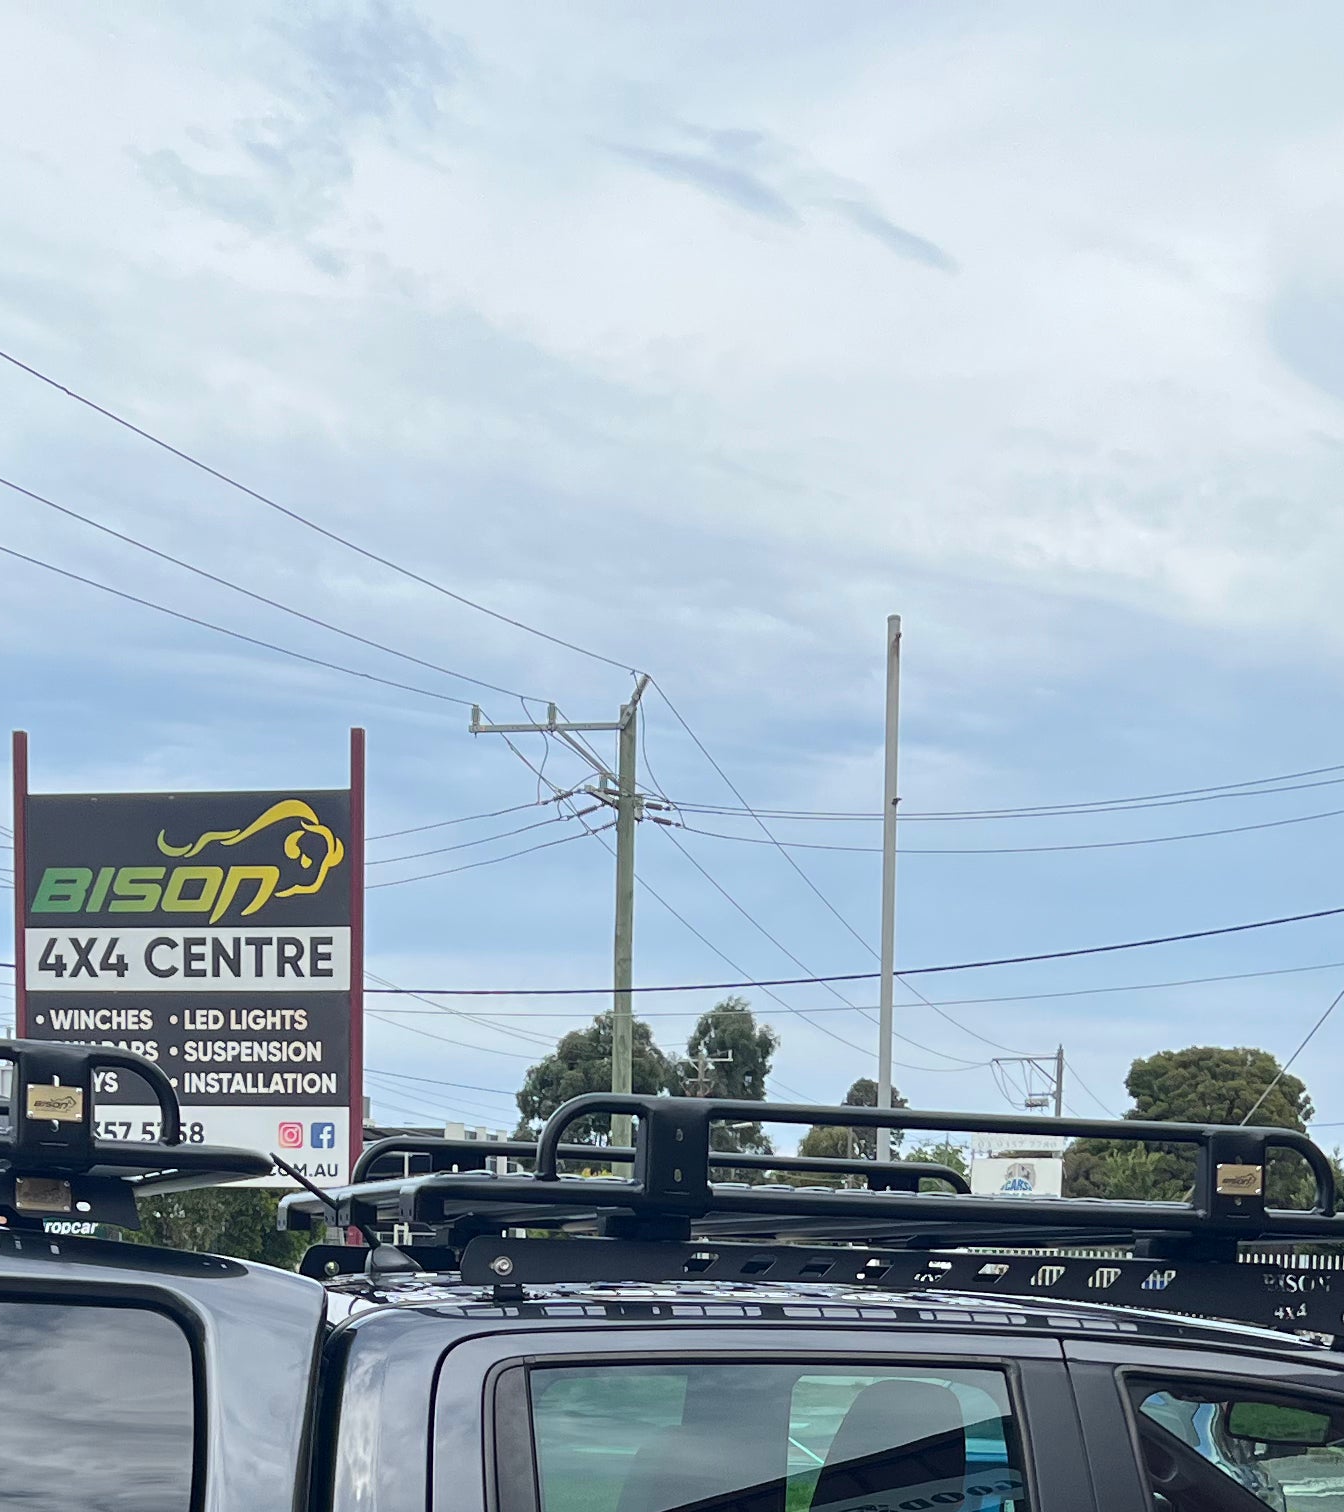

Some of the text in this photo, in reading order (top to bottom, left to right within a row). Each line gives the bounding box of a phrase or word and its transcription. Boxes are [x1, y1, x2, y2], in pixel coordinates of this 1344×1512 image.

[30, 865, 280, 925] BISON
[38, 936, 334, 979] 4X4 CENTRE
[49, 1008, 309, 1031] WINCHES LED LIGHTS
[183, 1040, 323, 1062] SUSPENSION
[183, 1072, 338, 1094] INSTALLATION
